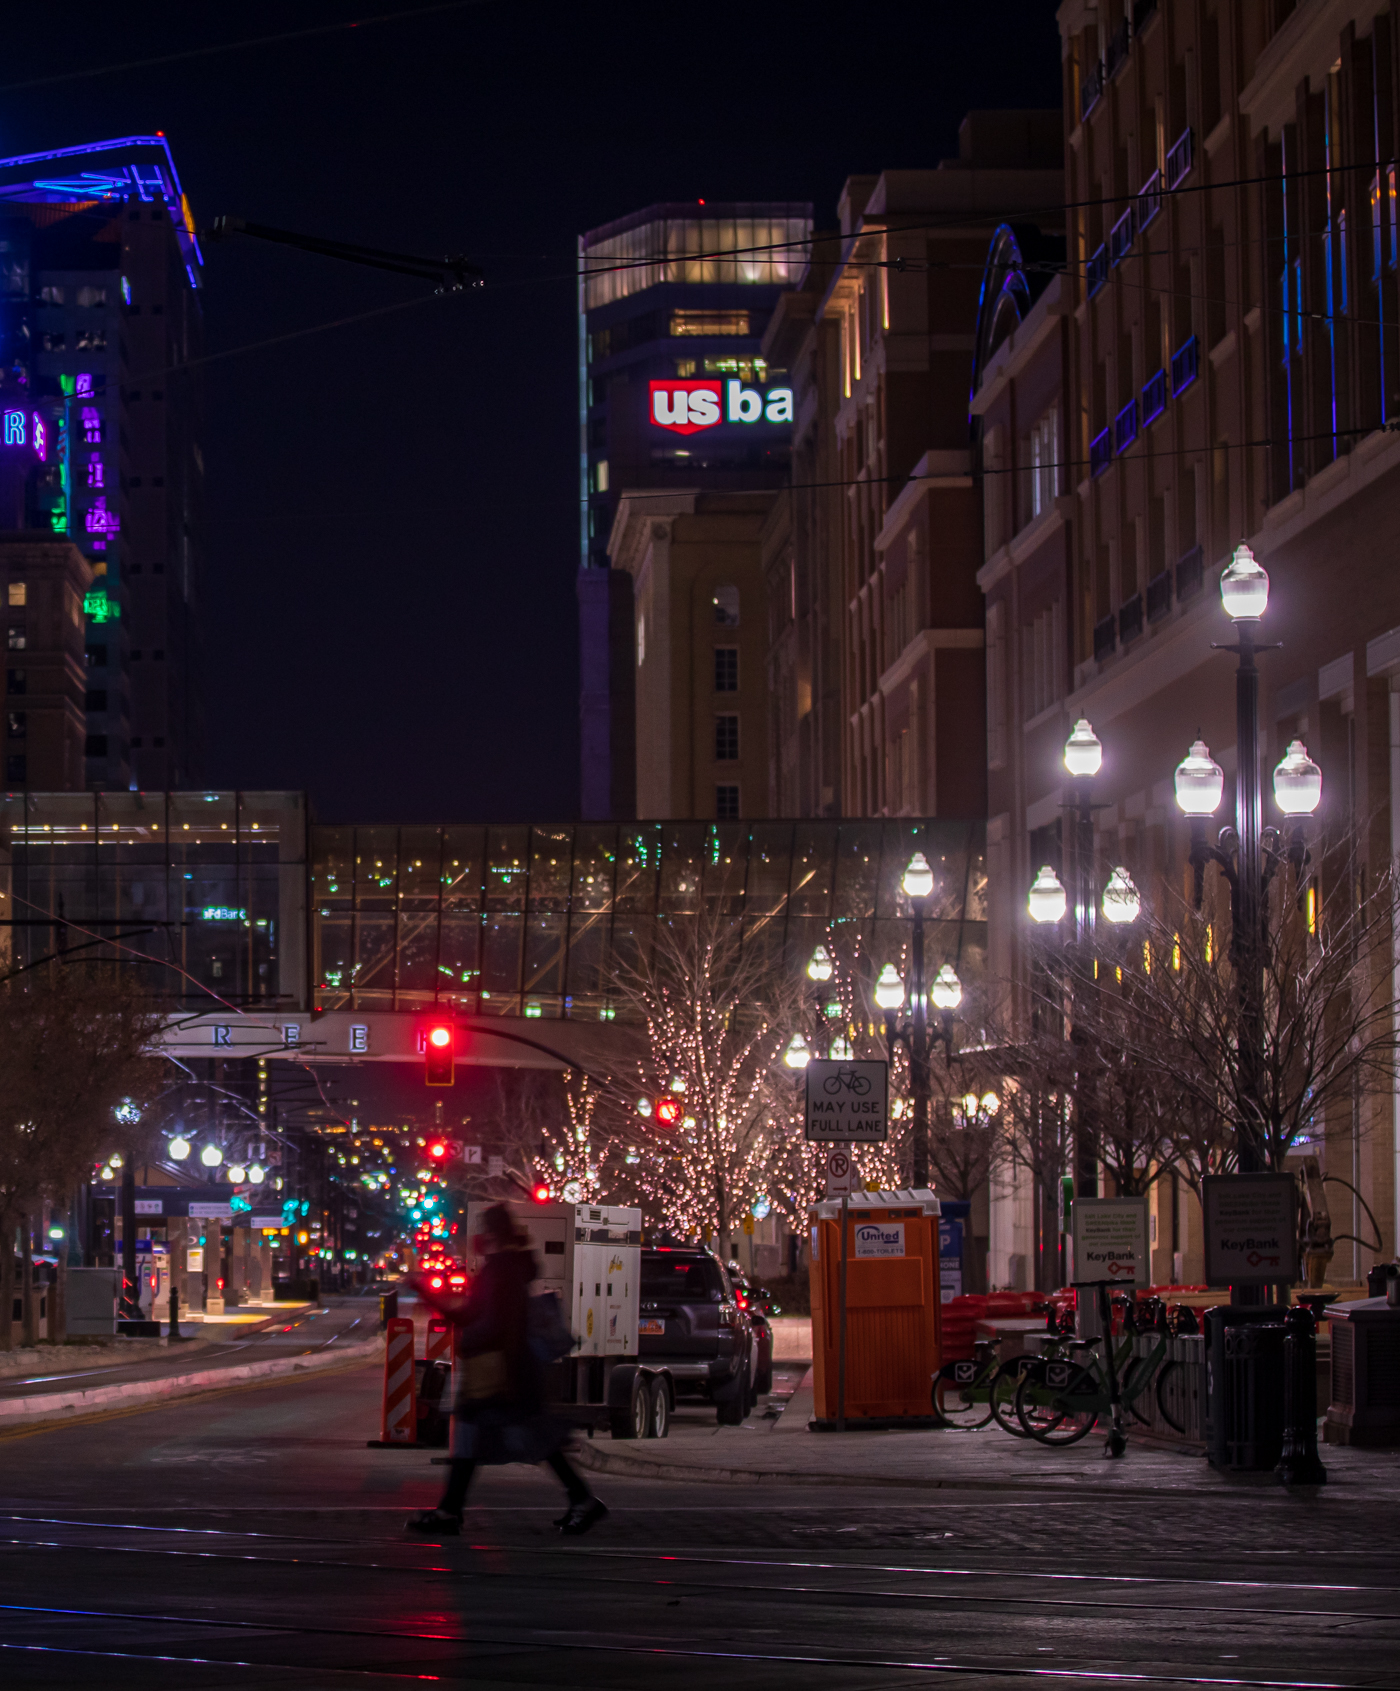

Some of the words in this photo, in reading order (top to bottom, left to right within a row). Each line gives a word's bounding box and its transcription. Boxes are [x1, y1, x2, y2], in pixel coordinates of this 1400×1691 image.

[813, 1101, 845, 1114] MAY
[851, 1101, 880, 1114] USE
[811, 1119, 843, 1132] FULL
[848, 1120, 882, 1132] LANE
[861, 1230, 900, 1241] United
[1221, 1238, 1279, 1252] KeyBank
[1086, 1251, 1135, 1262] KeyBank
